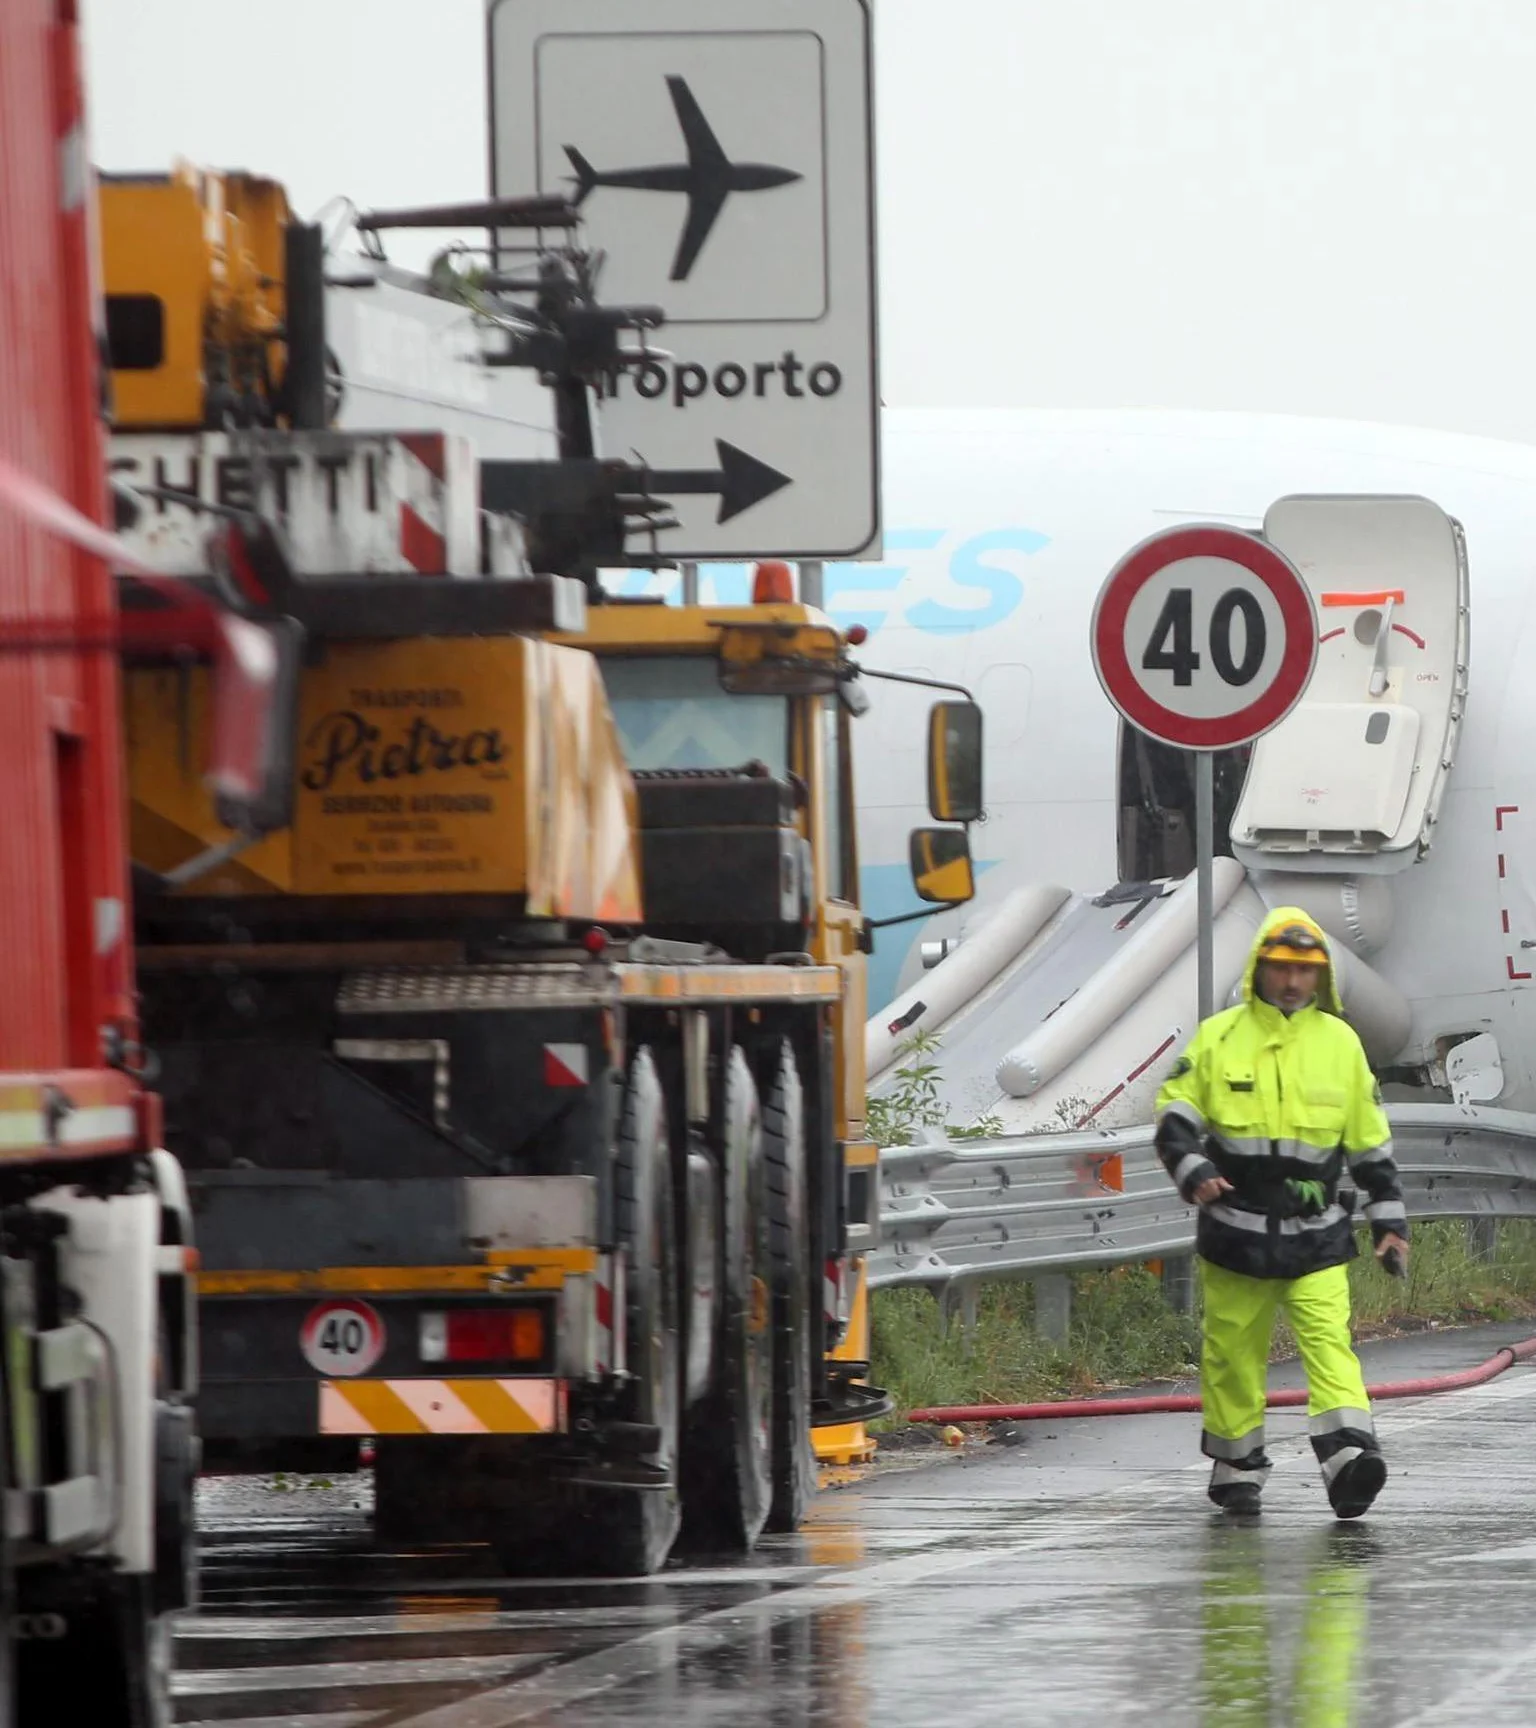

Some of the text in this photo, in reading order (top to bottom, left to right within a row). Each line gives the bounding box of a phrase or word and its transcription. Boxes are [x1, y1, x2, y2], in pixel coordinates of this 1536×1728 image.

[603, 350, 842, 408] roporto
[1142, 587, 1267, 687] 40
[302, 710, 508, 790] Pietra
